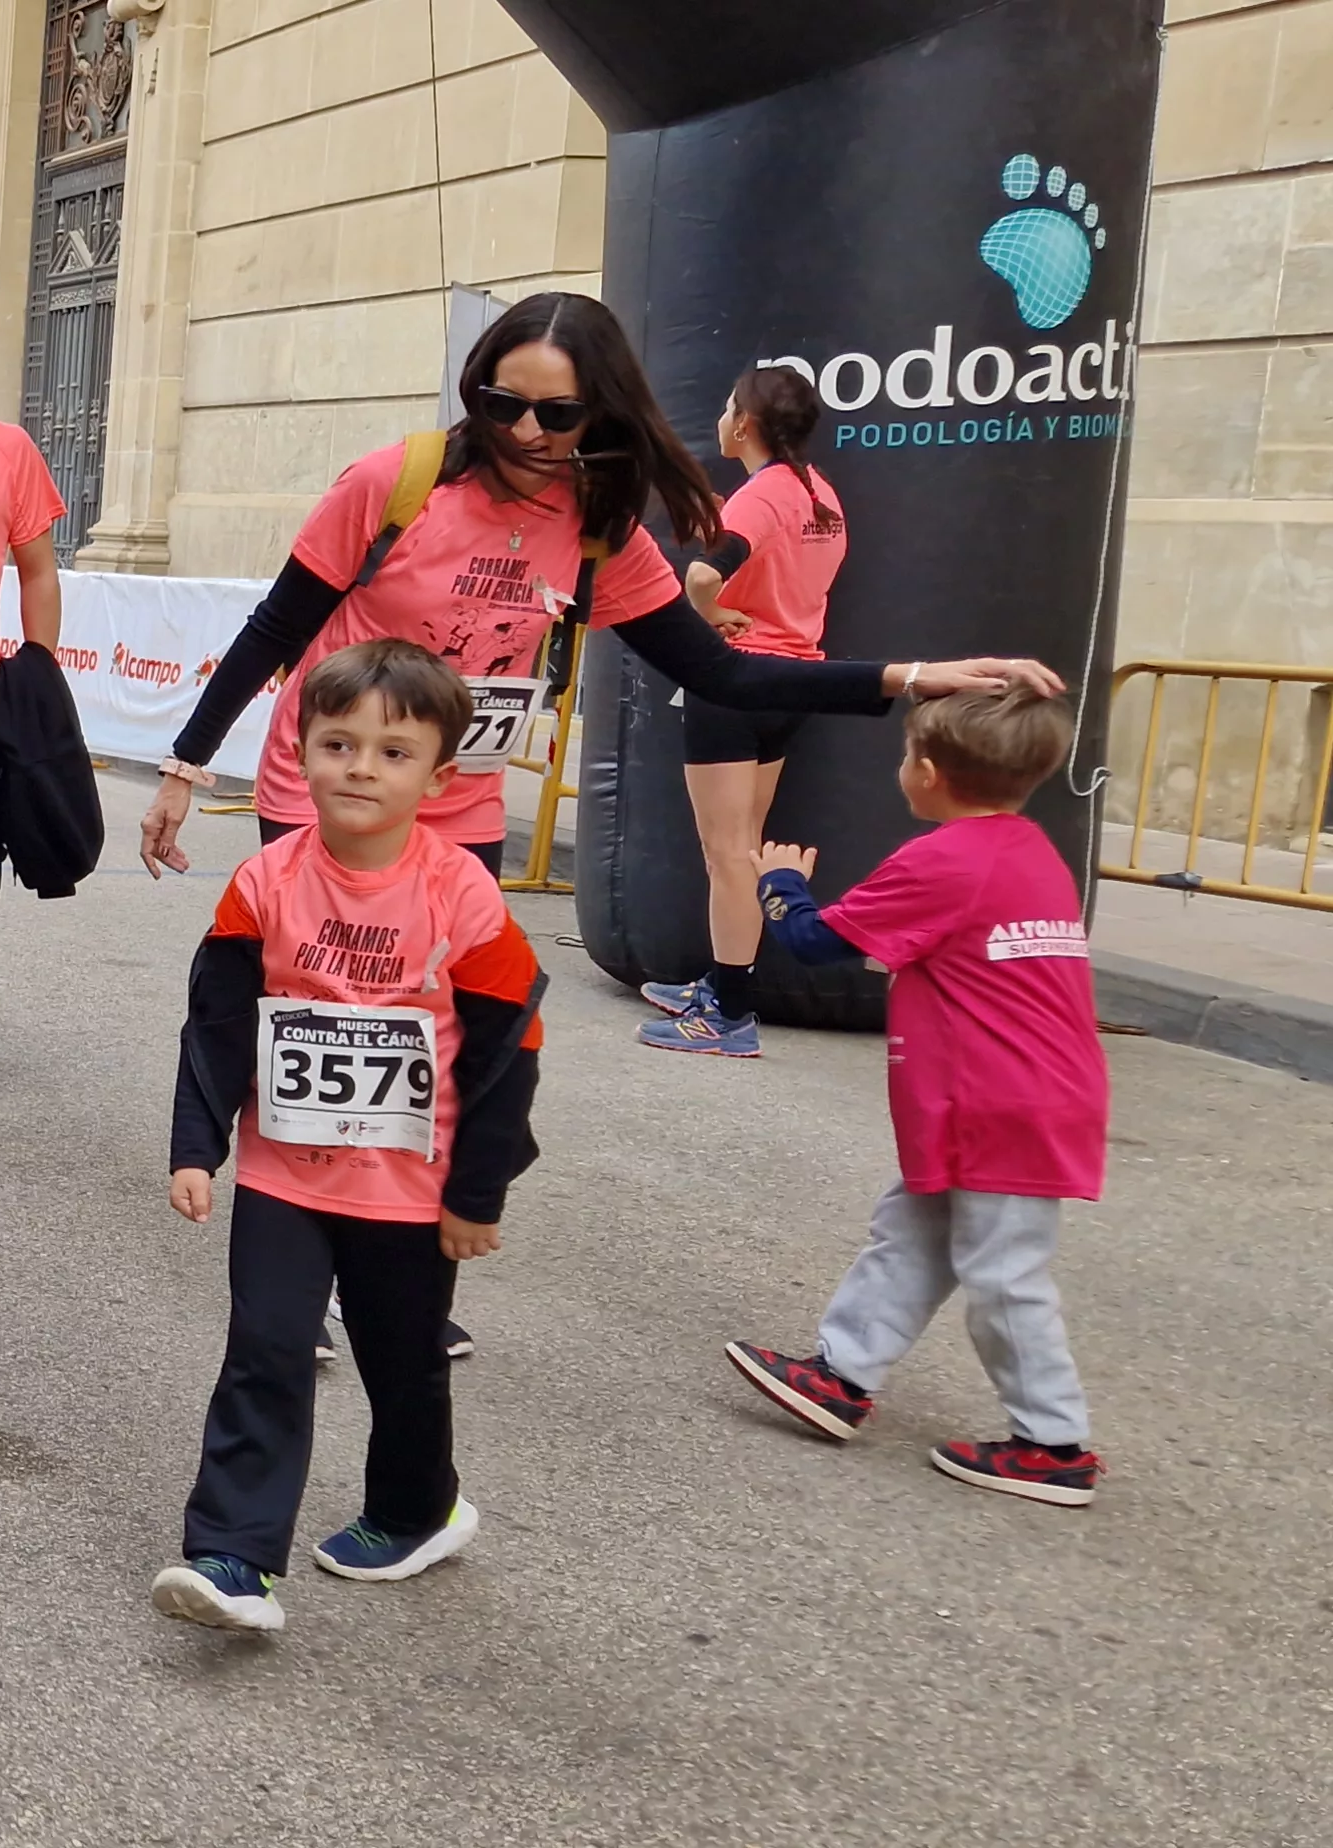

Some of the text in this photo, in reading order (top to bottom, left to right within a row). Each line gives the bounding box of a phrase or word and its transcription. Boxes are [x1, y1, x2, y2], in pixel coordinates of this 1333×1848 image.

[836, 411, 1034, 449] PODOLOGÍA
[1045, 415, 1061, 439] Y
[450, 574, 478, 596] POR
[476, 577, 494, 599] LA
[110, 641, 181, 688] Alcampo
[481, 696, 525, 709] CÁNCER
[317, 919, 400, 955] CORRAMOS
[293, 942, 405, 984] POR LA CIENCIA
[283, 1026, 350, 1045] CONTRA
[354, 1033, 373, 1047] EL
[337, 1020, 388, 1032] HUESCA
[276, 1049, 433, 1110] 3579
